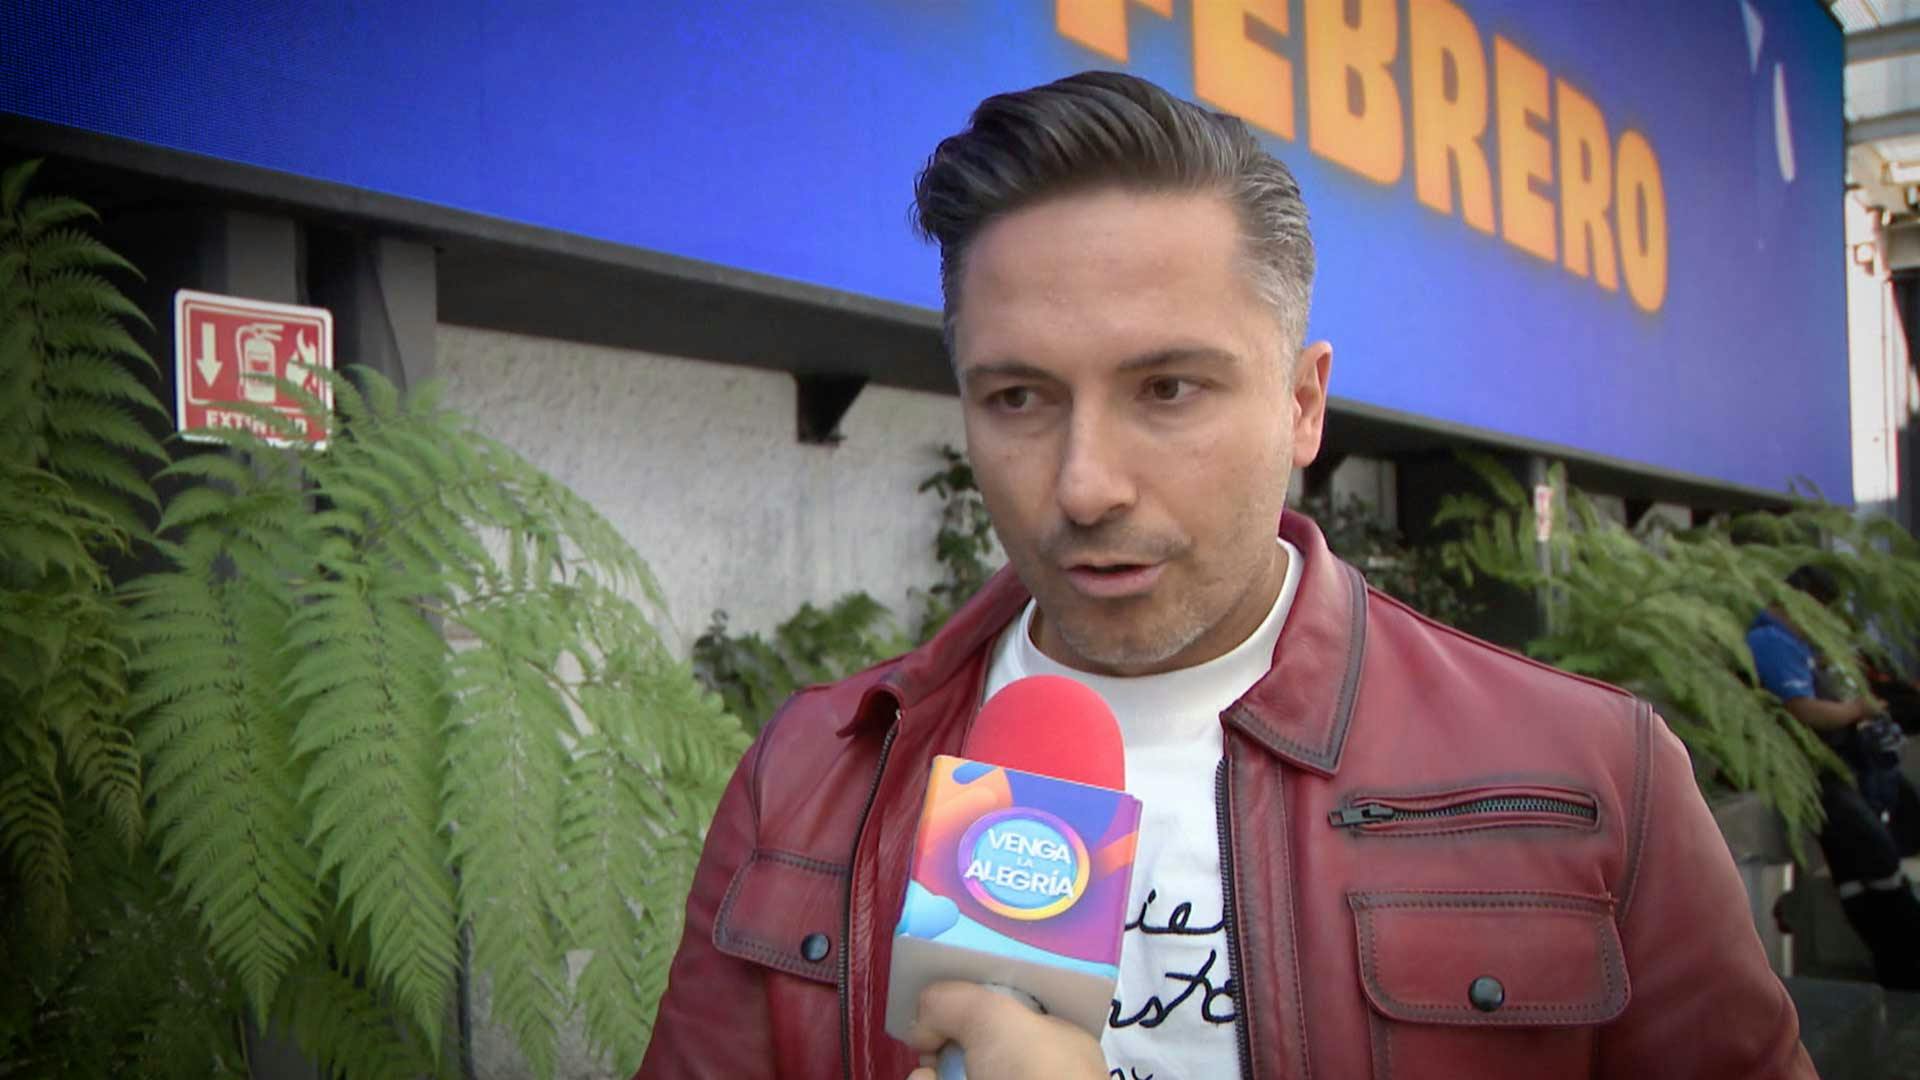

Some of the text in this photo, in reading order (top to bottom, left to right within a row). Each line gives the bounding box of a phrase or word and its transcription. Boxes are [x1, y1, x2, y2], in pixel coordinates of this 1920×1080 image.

[1056, 0, 1668, 312] EBRERO
[987, 828, 1072, 864] VENGA
[1016, 857, 1034, 868] LA
[963, 859, 1074, 898] ALEGRÍA
